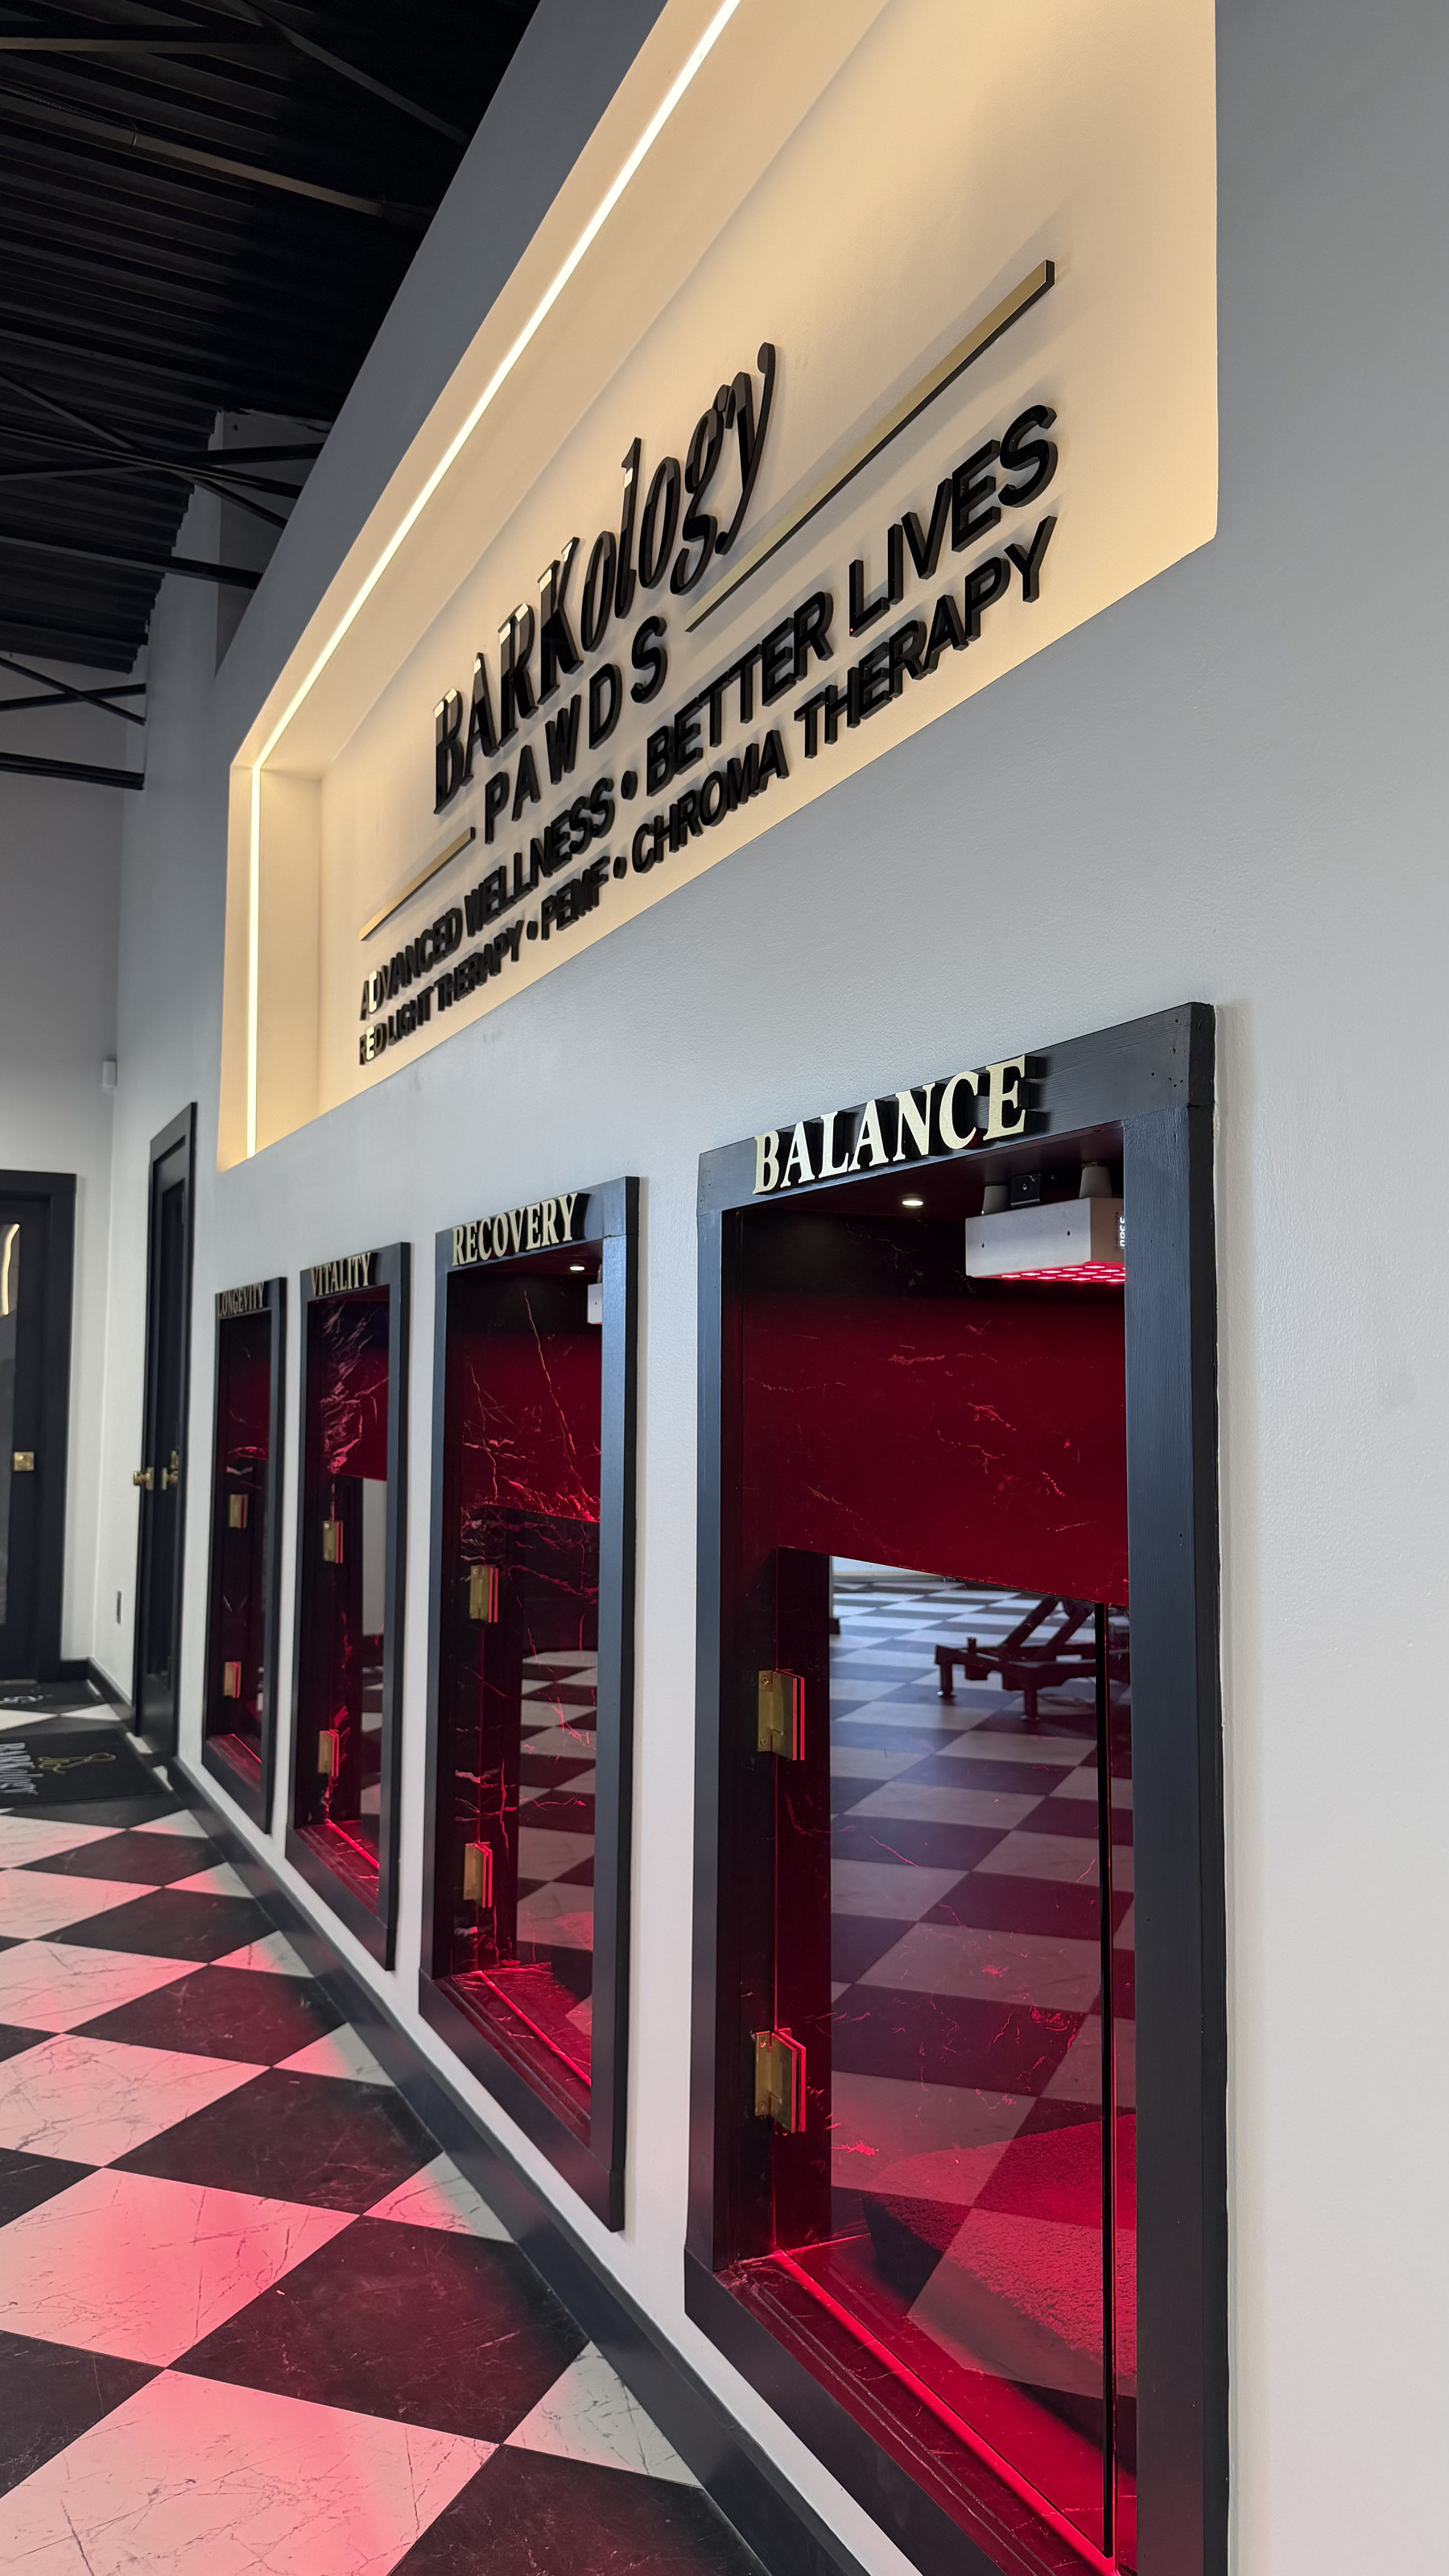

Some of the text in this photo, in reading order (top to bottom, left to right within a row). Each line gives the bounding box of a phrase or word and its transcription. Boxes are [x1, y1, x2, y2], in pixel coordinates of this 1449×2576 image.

[433, 342, 776, 815] BARKology
[360, 404, 1059, 1021] ADVANCED WELLNESS BETTER LIVES
[360, 516, 1058, 1066] RED LIGHT THERAPY PEMF CHROMA THERAPY
[485, 614, 668, 844] PAWDS
[753, 1055, 1027, 1195] BALANCE
[217, 1282, 264, 1317] LONGEVITY
[311, 1252, 373, 1296] VITALITY
[452, 1193, 580, 1266] RECOVERY
